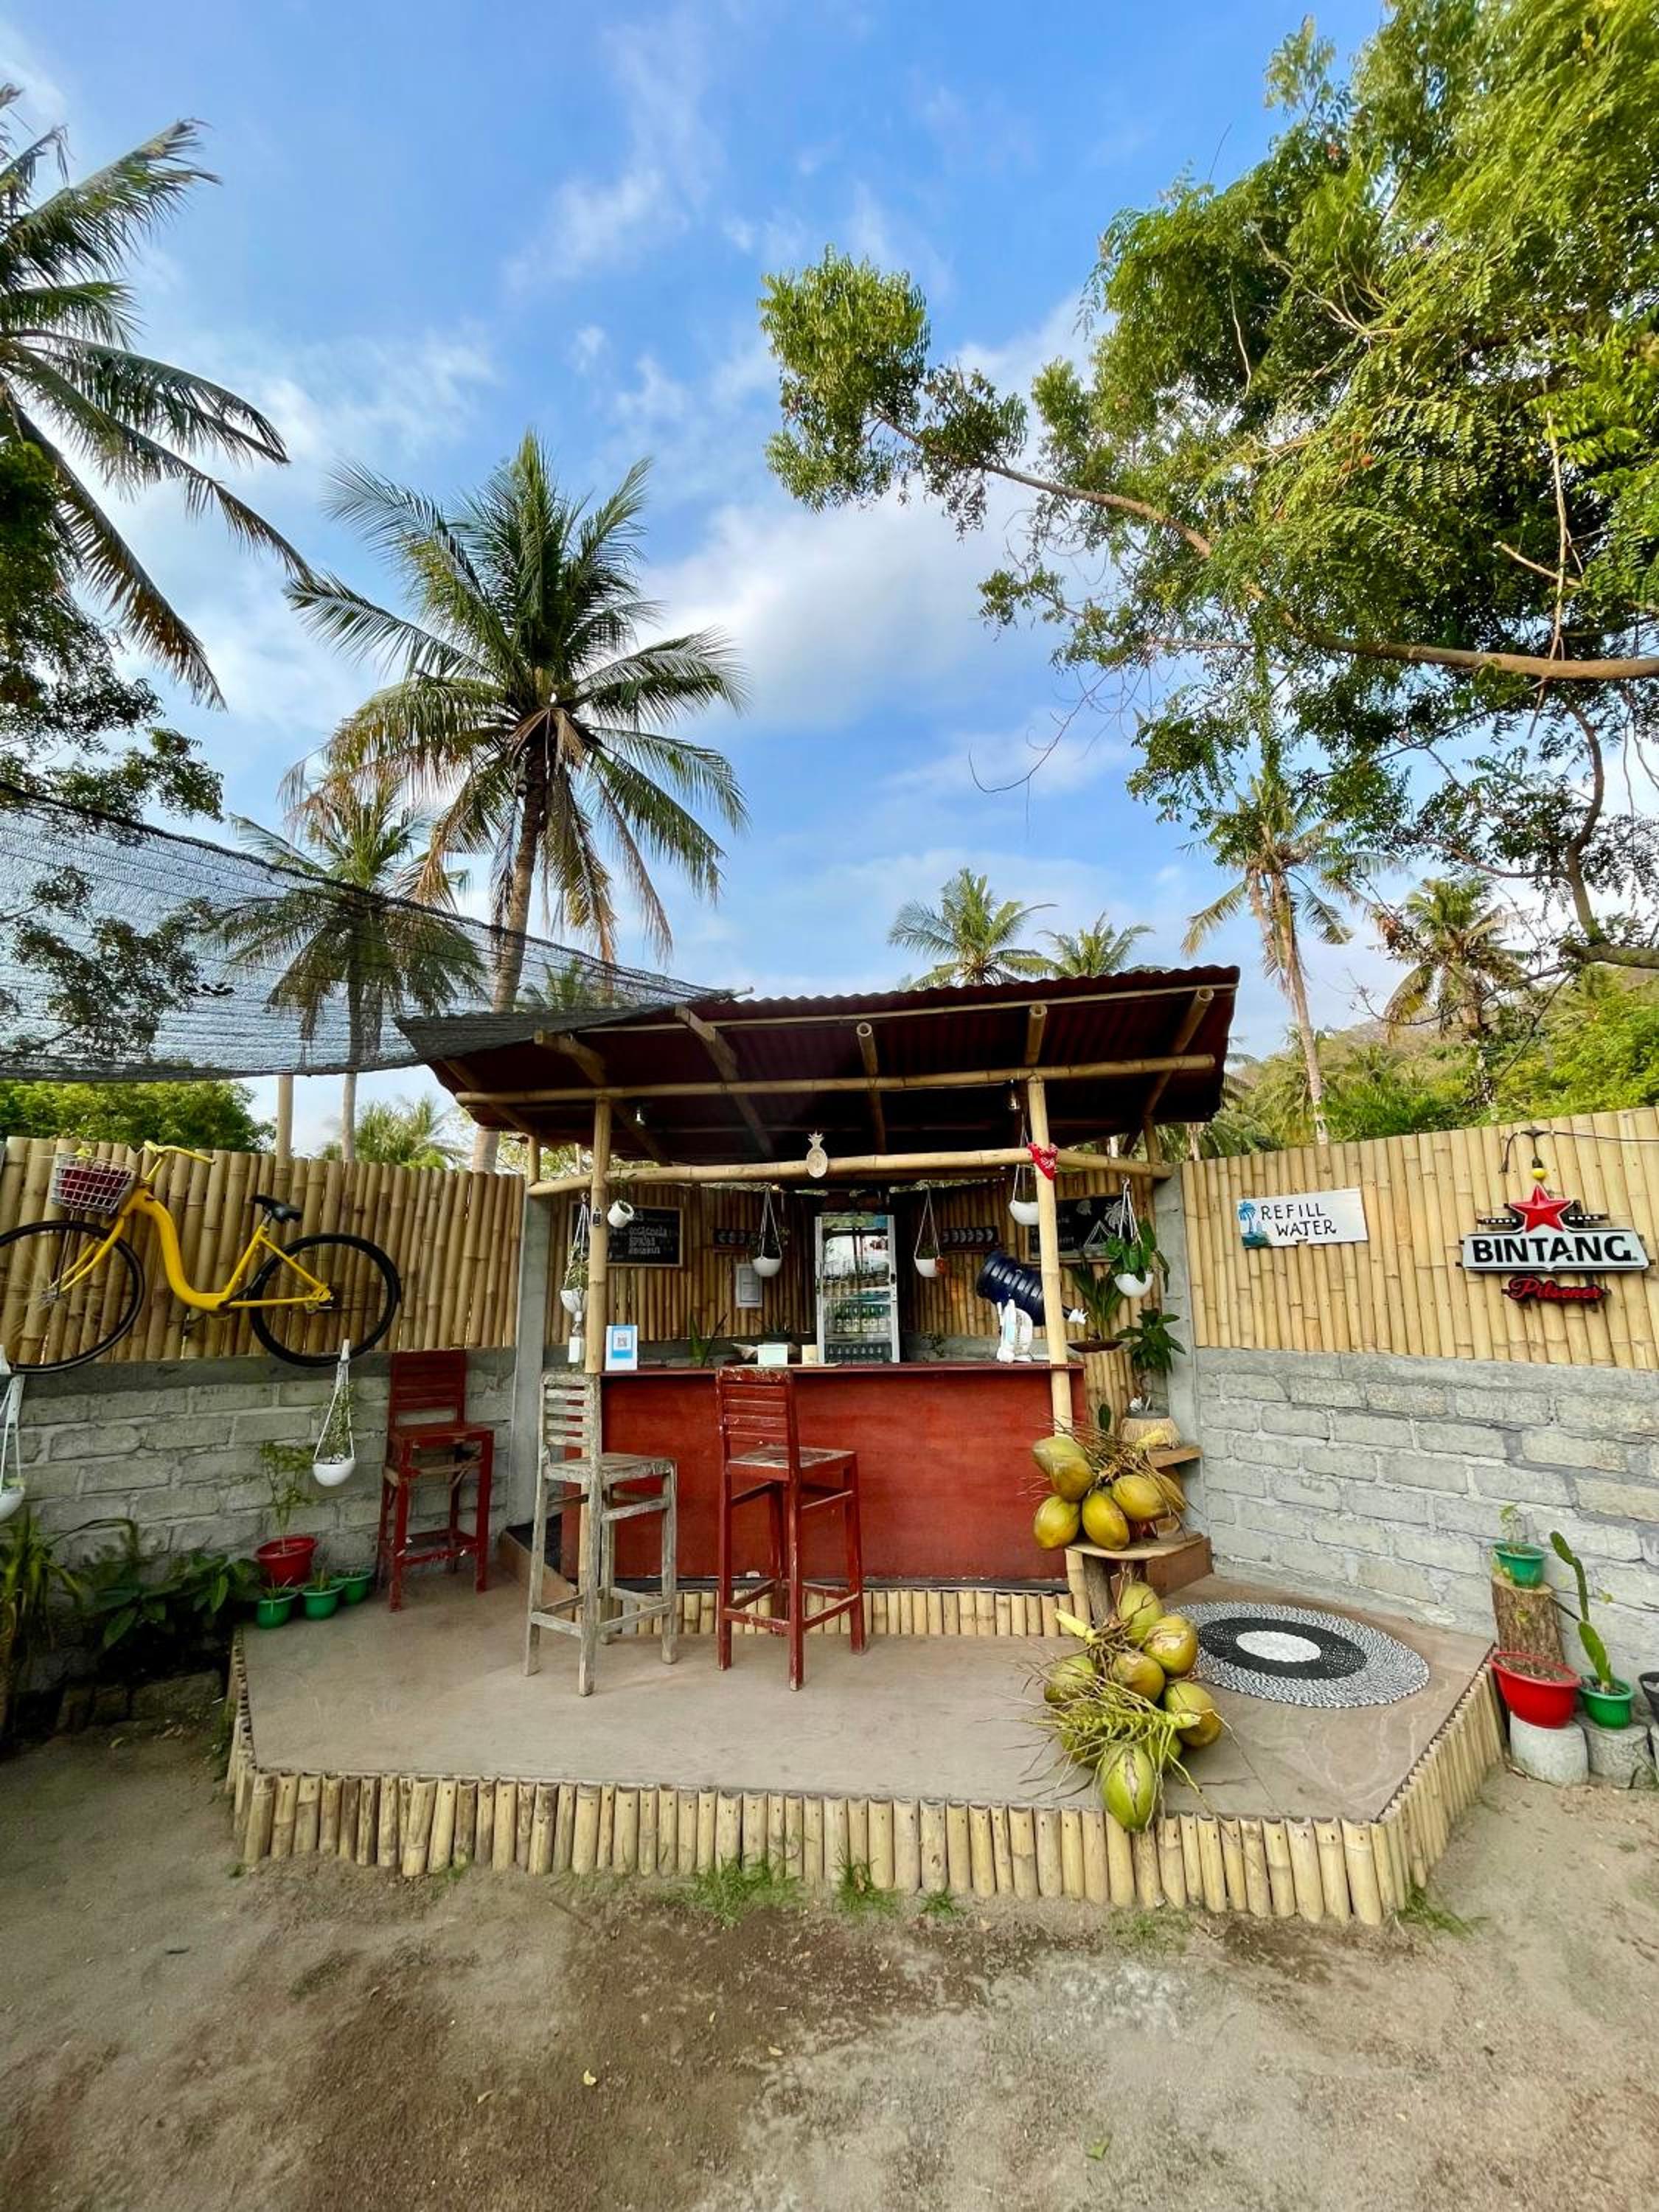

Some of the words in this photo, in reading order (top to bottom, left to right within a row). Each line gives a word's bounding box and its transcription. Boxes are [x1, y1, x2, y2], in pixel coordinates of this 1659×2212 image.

[1261, 1203, 1326, 1220] REFILL
[1276, 1219, 1337, 1237] WATER
[1472, 1236, 1632, 1262] BINTANG
